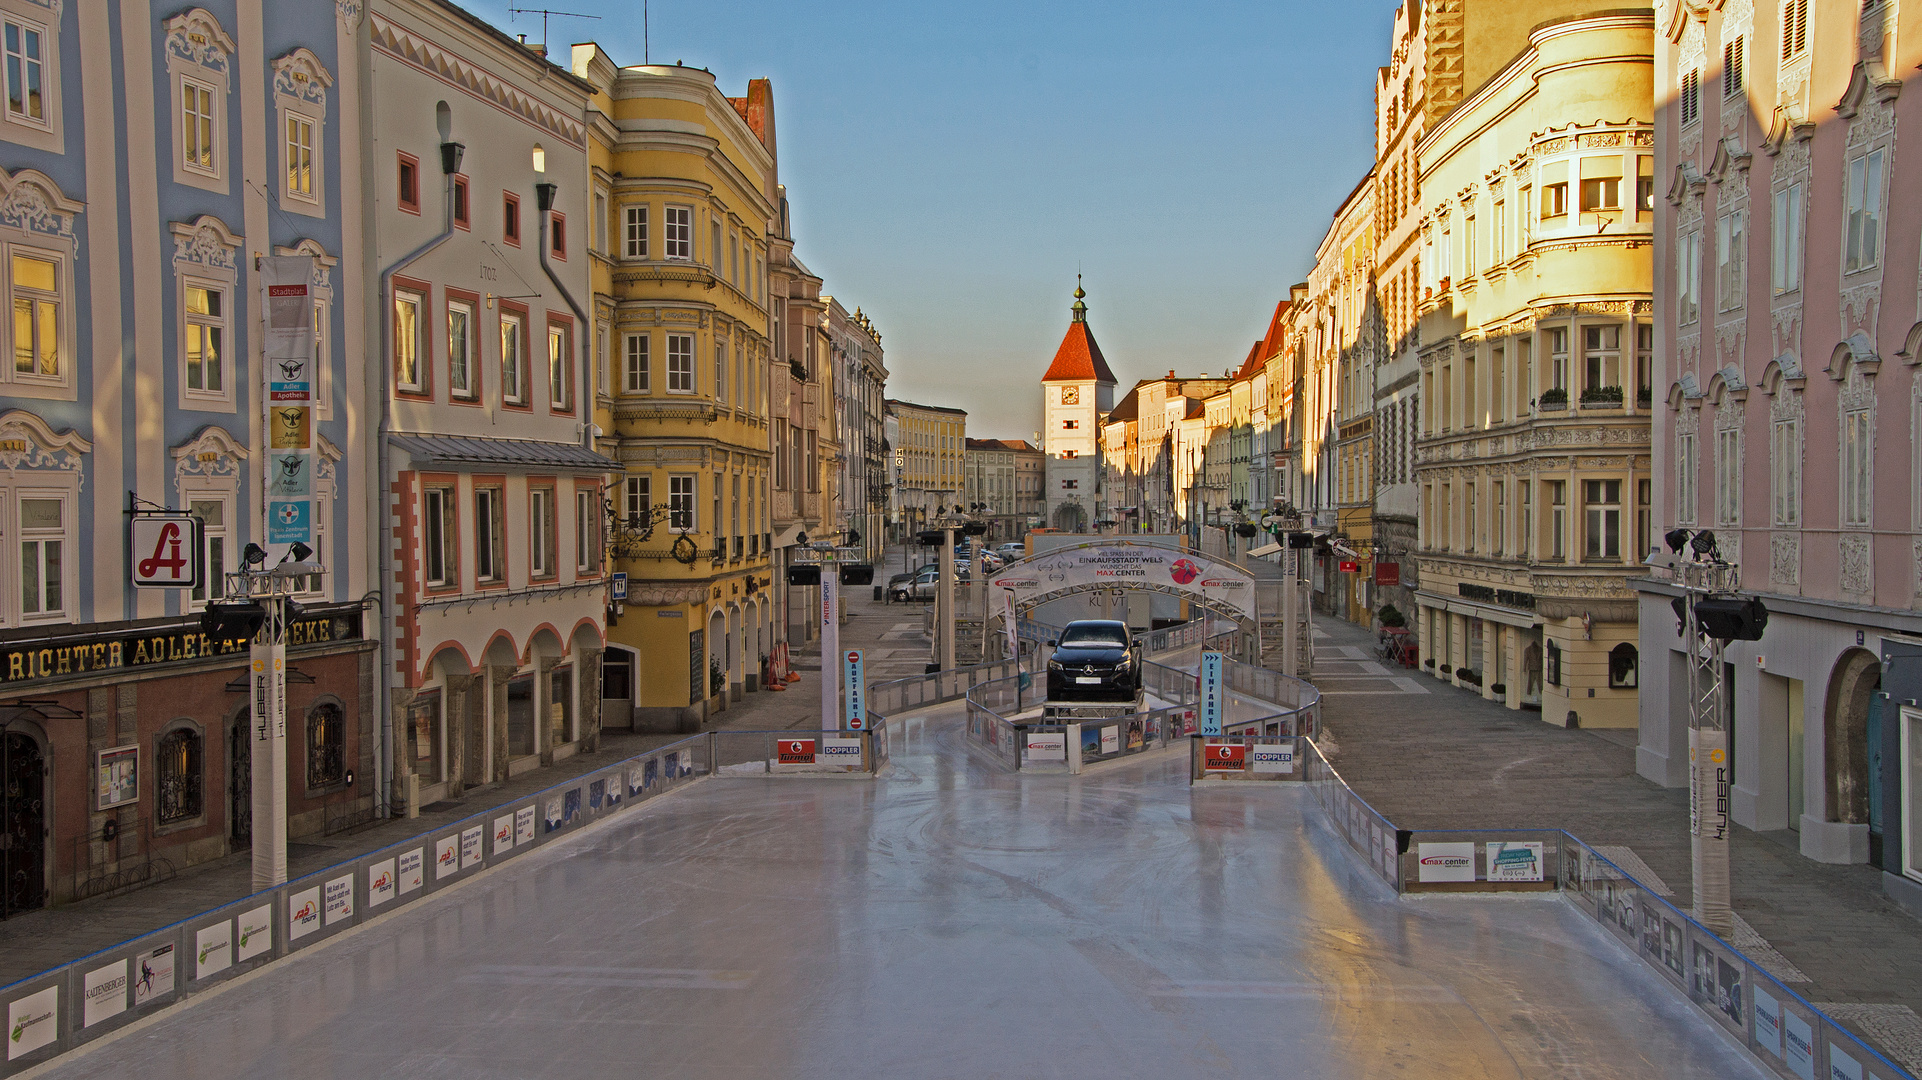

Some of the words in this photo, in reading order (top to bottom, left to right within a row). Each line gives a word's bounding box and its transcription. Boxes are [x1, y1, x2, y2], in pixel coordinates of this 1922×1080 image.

[851, 663, 859, 718] AUSFAHRT
[257, 675, 267, 741] HUBER
[1714, 767, 1727, 840] HUBER
[501, 836, 511, 844] tours
[444, 857, 456, 866] tours
[1426, 858, 1470, 866] max.center
[379, 883, 392, 893] tours
[301, 914, 317, 924] tours
[86, 975, 126, 1000] KALTENBERGER
[1755, 1004, 1775, 1026] SPARKASSE
[1786, 1028, 1808, 1052] SPARKASSE
